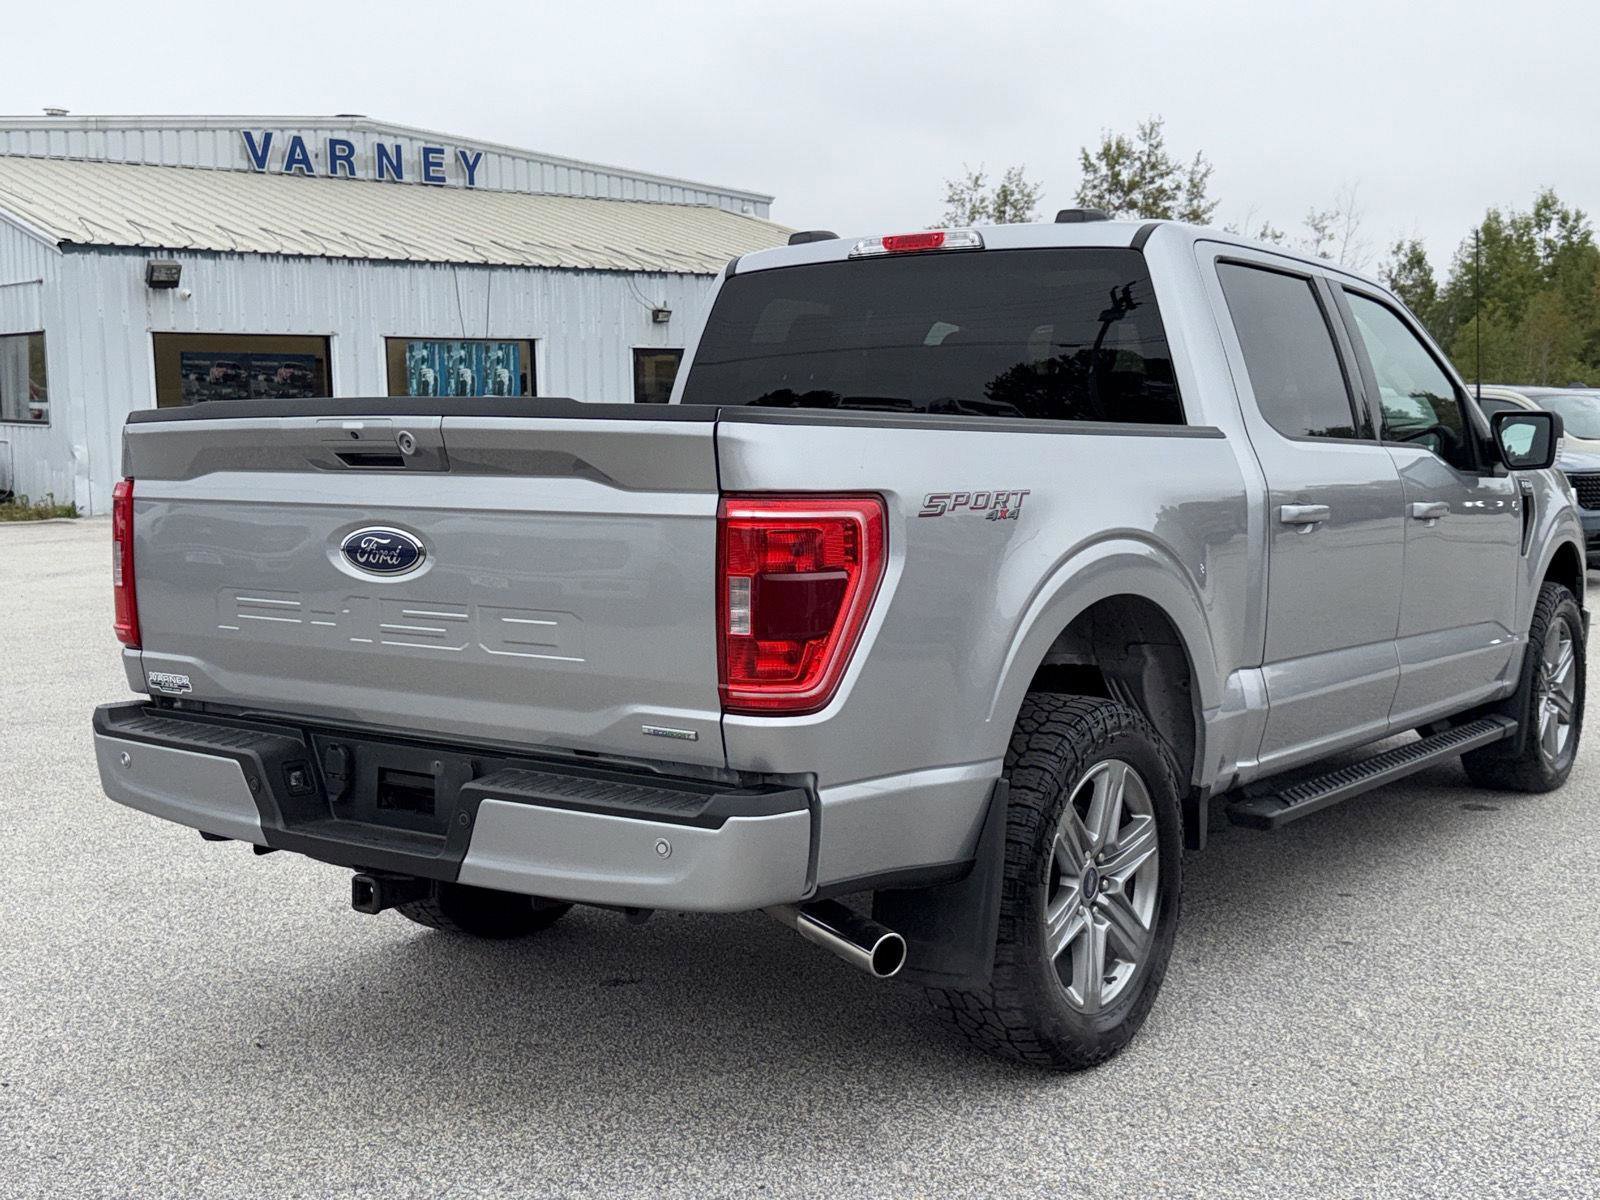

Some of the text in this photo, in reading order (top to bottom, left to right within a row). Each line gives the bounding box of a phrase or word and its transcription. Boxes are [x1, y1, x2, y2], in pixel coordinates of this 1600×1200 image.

[242, 130, 482, 187] VARNEY
[918, 489, 1031, 518] SPORT
[356, 536, 402, 565] Ford
